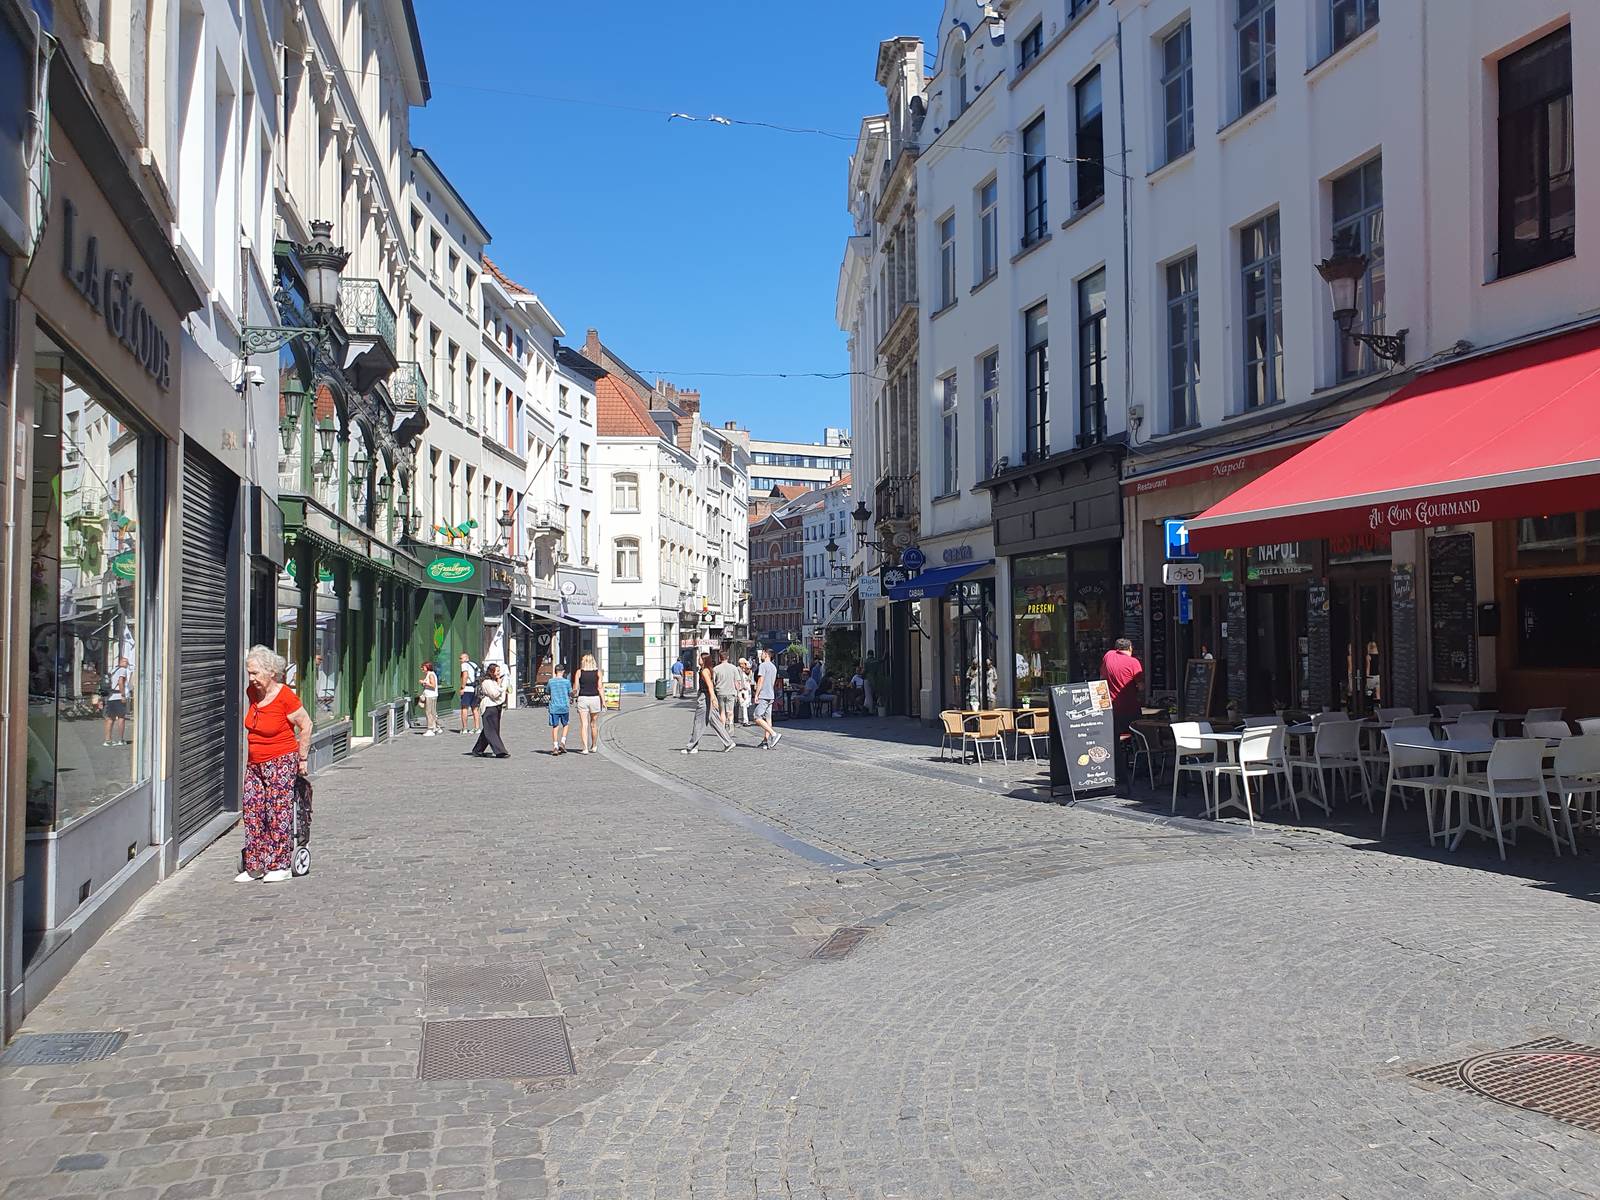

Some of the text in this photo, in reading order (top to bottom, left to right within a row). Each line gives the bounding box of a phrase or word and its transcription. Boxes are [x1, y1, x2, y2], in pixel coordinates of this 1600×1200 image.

[1213, 459, 1246, 476] Napoli
[1137, 479, 1168, 491] Restaurant
[1415, 499, 1480, 525] GOURMAND
[1258, 541, 1299, 561] NAPOLI
